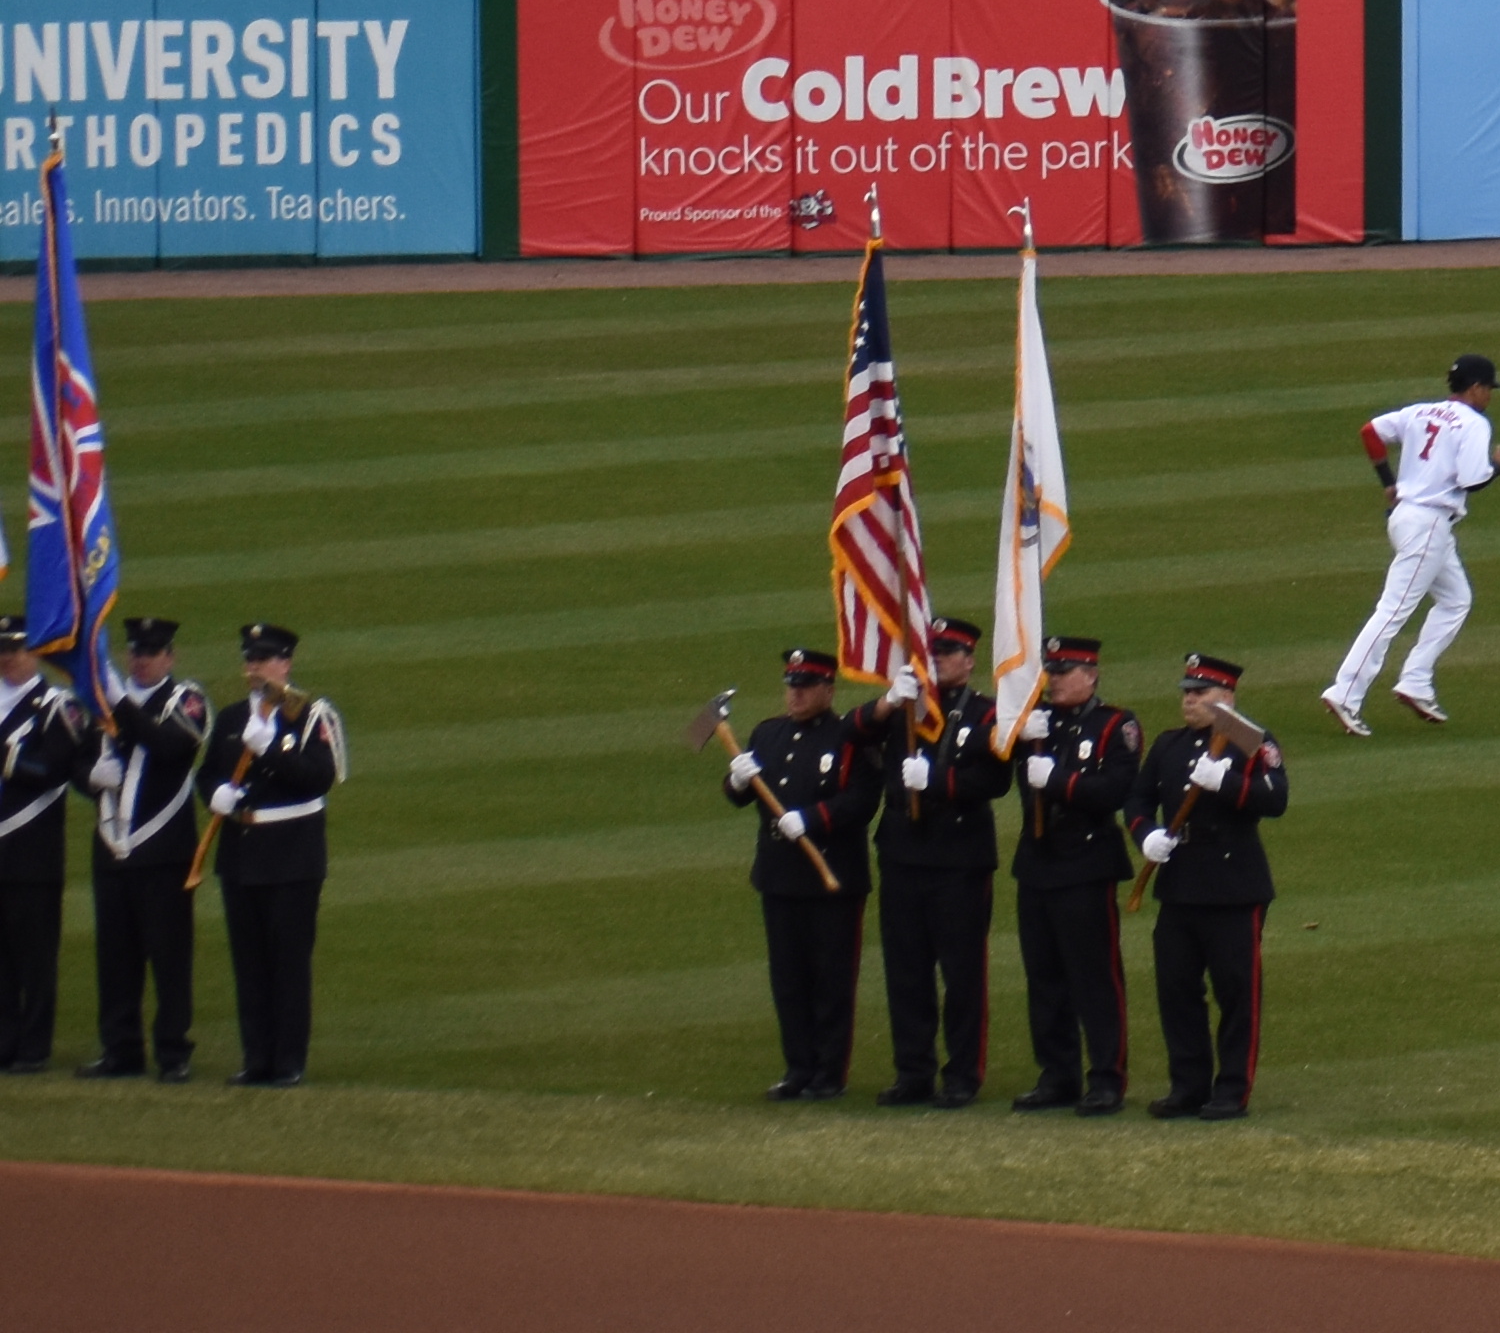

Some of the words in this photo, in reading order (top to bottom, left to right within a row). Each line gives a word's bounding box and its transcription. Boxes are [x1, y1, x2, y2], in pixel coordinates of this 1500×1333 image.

[0, 19, 408, 103] NIVERSITY
[638, 79, 730, 124] Our
[742, 54, 919, 122] Cold
[932, 56, 1126, 120] Brew
[4, 112, 402, 171] RTHOPEDICS
[638, 136, 784, 177] knocks
[795, 135, 822, 175] it
[830, 137, 897, 175] out
[909, 132, 952, 172] of
[960, 132, 1027, 172] the
[1041, 131, 1134, 180] park
[0, 191, 84, 226] ales.
[95, 189, 255, 223] Innovators.
[266, 185, 406, 221] Teachers.
[640, 207, 681, 221] Proud
[684, 207, 741, 222] Sponsor
[744, 206, 757, 219] of
[759, 205, 781, 218] the
[1418, 420, 1441, 461] 7
